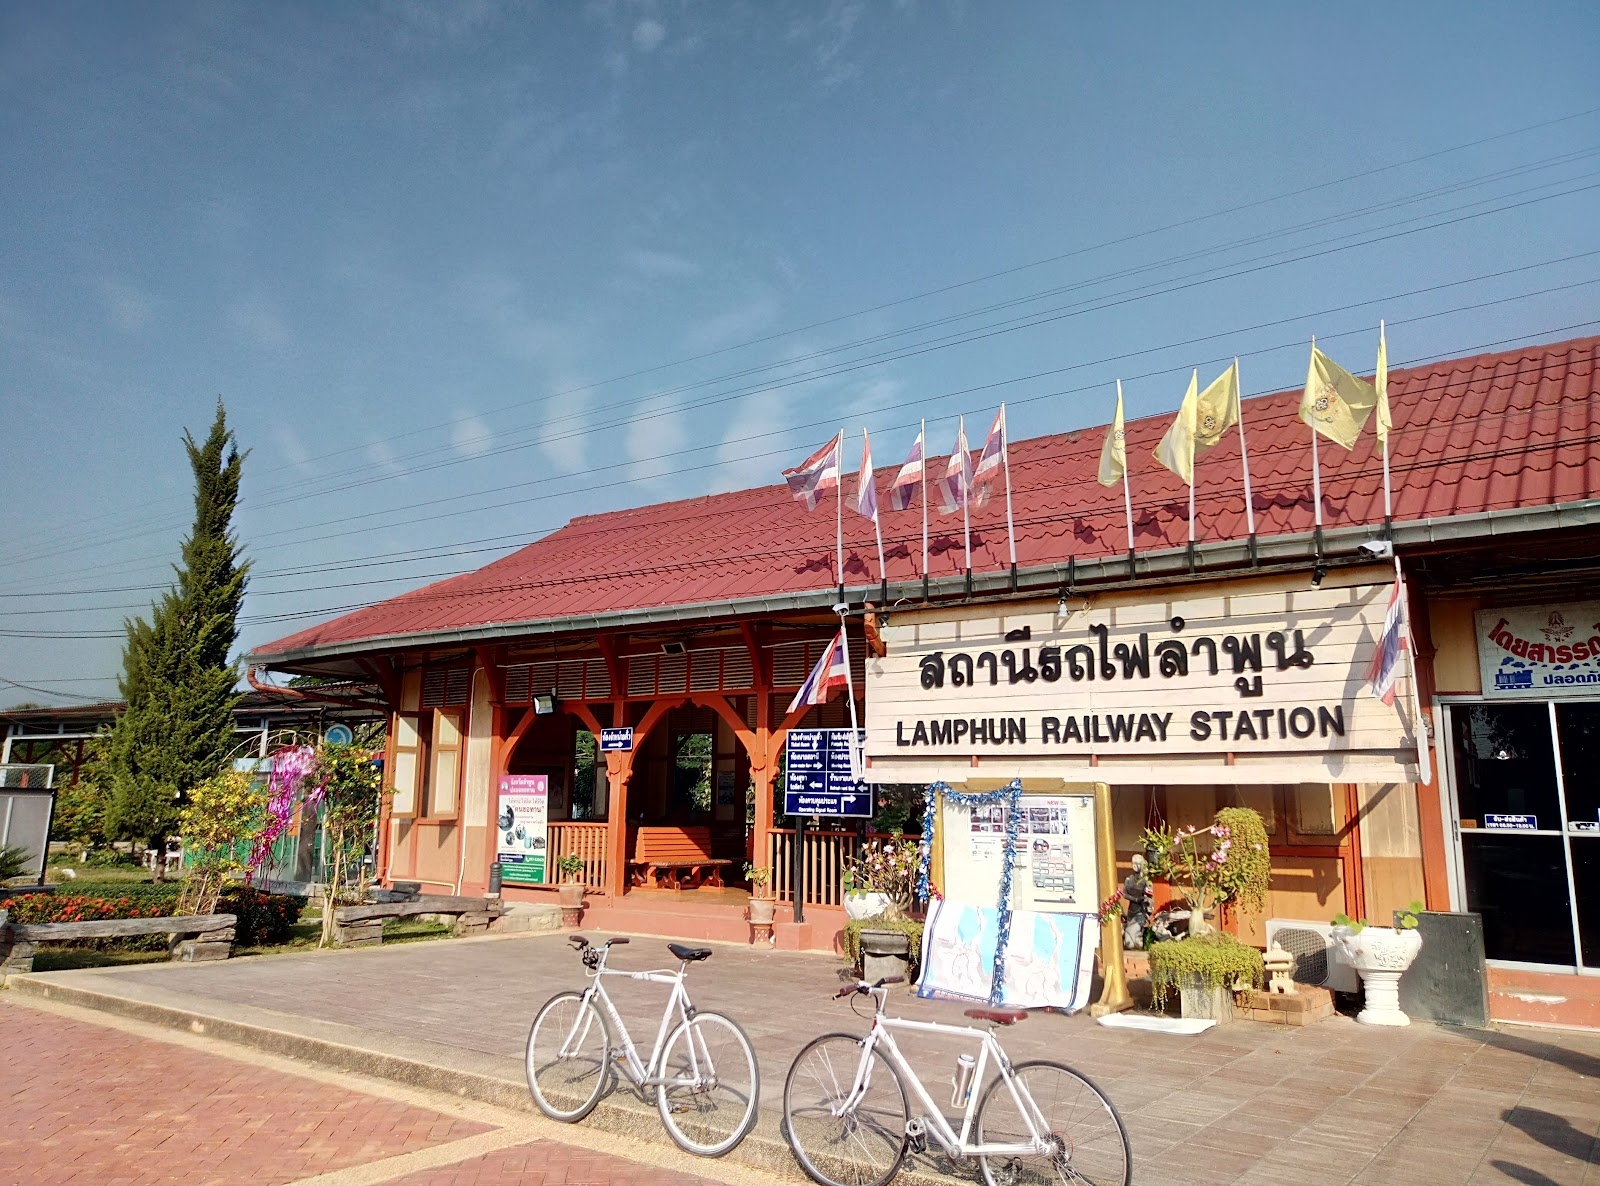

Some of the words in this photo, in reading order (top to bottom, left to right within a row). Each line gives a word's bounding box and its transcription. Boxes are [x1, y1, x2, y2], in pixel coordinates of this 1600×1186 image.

[919, 616, 1314, 697] สถานีรถไฟลำพูน
[1488, 617, 1600, 664] โดยสารรถ
[1543, 670, 1600, 685] ปลอดภั
[896, 717, 1027, 746] LAMPHUN
[1041, 712, 1174, 744] RAILWAY
[1190, 705, 1345, 741] STATION
